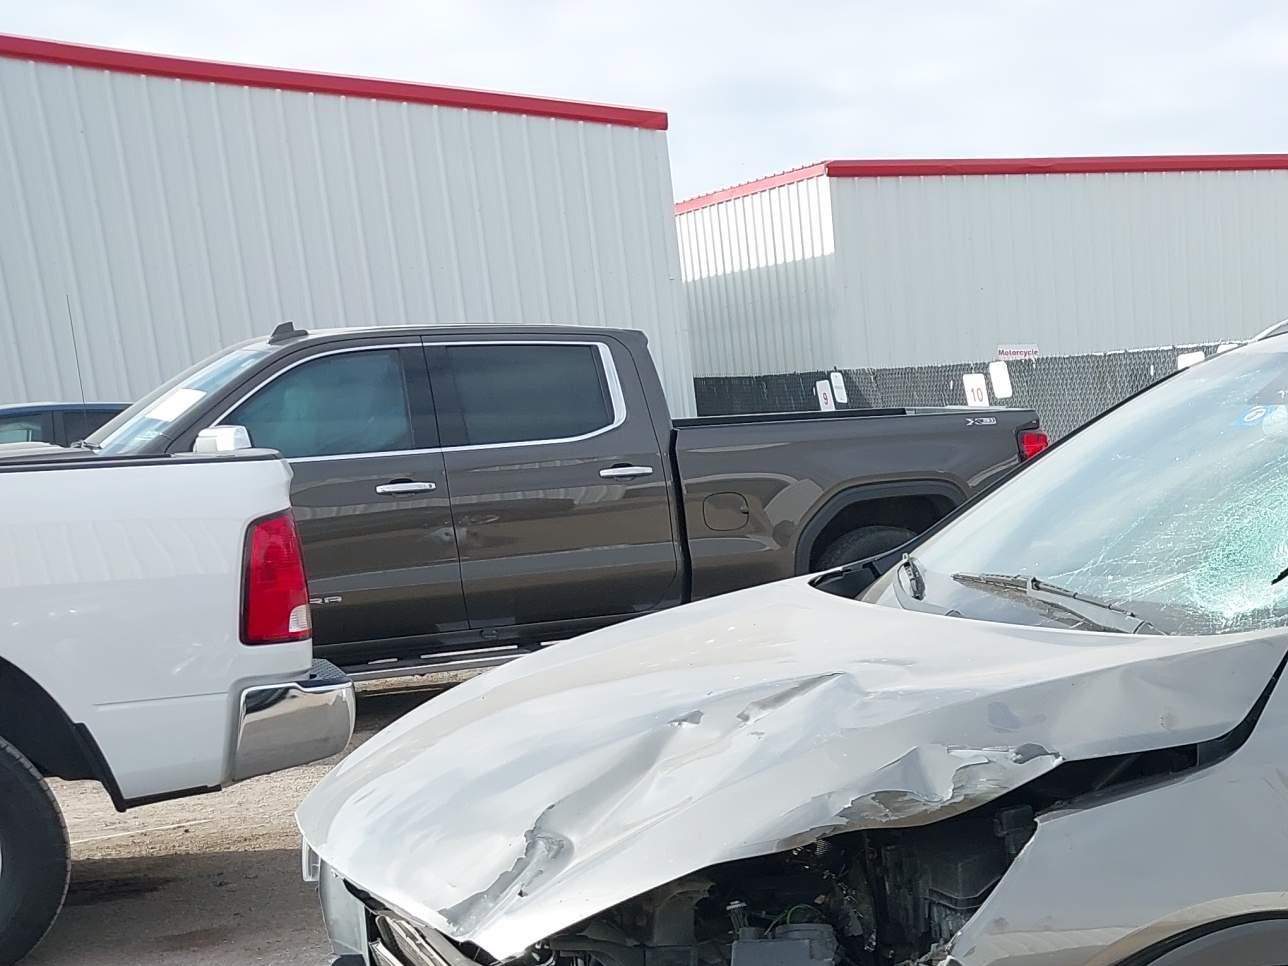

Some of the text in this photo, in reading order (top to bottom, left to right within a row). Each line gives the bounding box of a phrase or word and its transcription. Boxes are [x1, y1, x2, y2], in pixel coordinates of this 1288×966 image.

[998, 349, 1039, 357] Motorcycle
[822, 392, 829, 406] 9
[971, 386, 984, 403] 10
